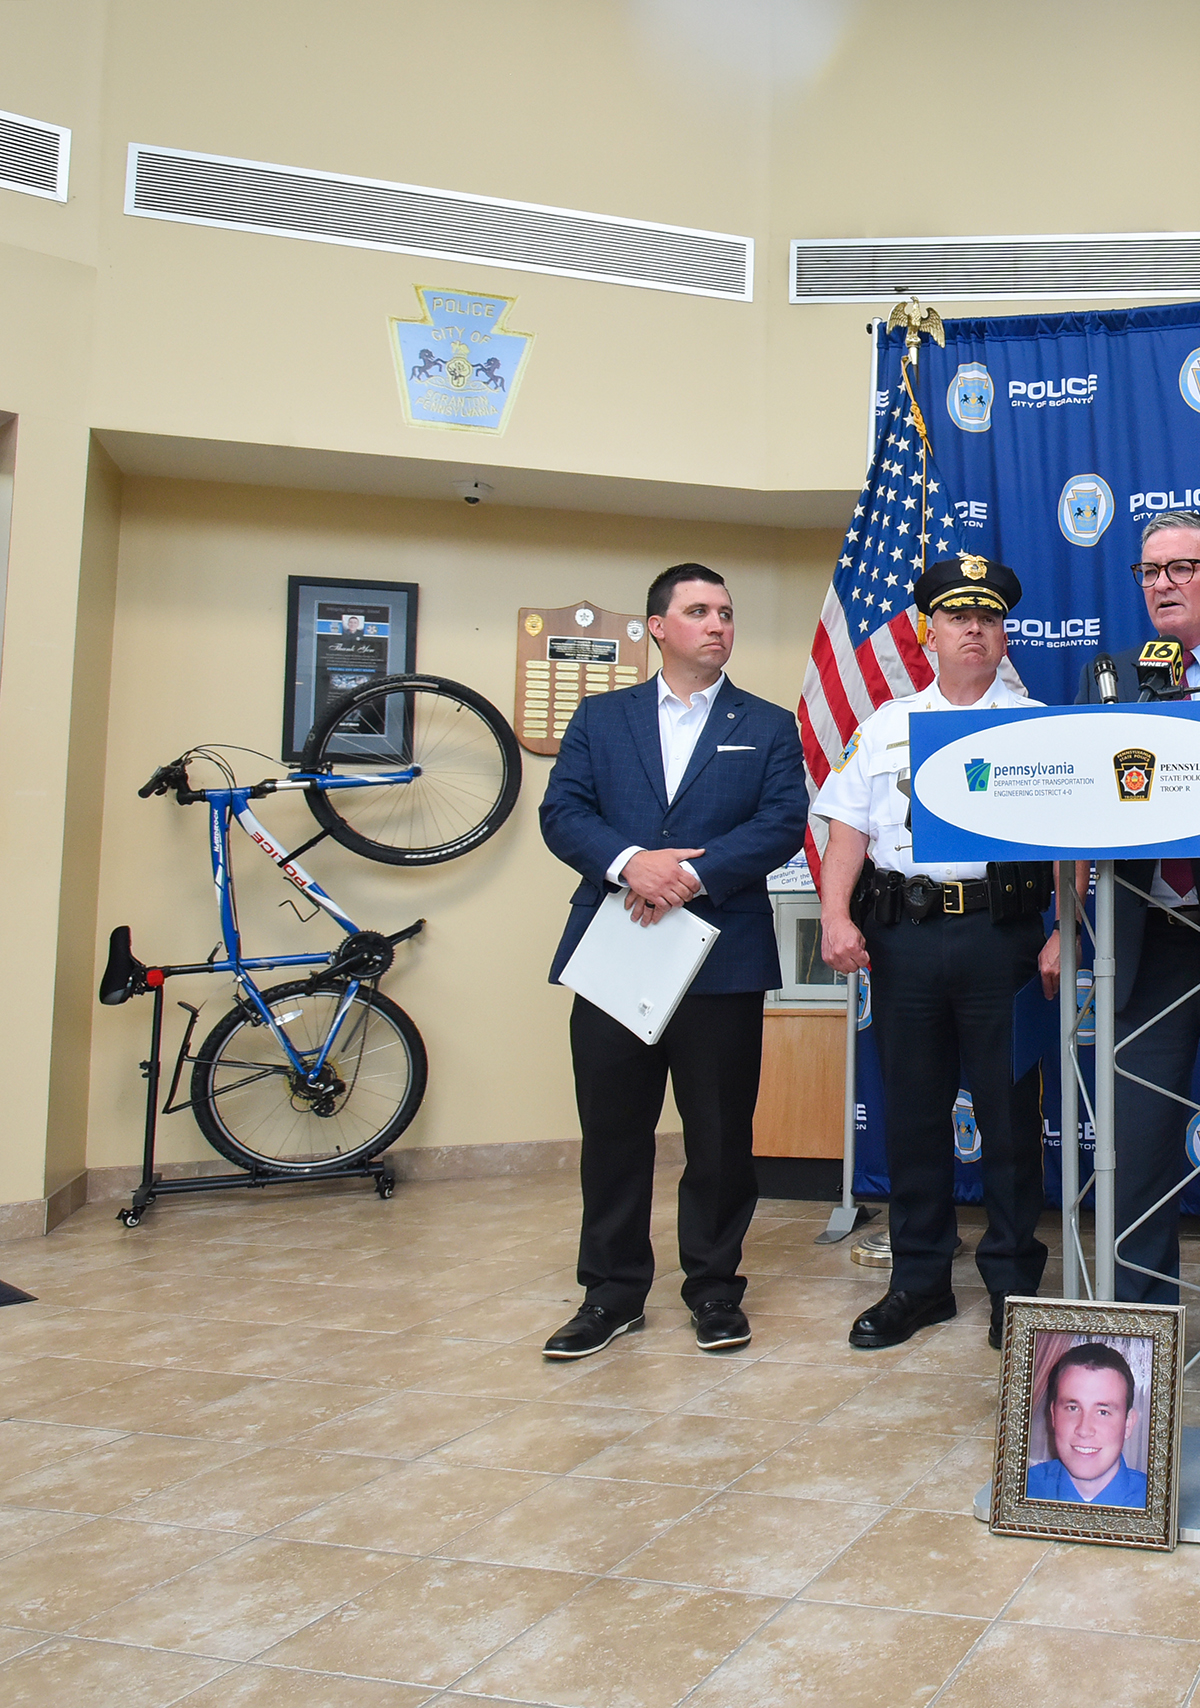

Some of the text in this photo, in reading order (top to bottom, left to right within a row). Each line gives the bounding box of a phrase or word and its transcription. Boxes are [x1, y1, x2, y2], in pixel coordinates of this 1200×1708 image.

[432, 296, 496, 318] POLICE
[431, 325, 493, 345] CITY OF
[1008, 373, 1098, 400] POLICE
[425, 389, 490, 407] SCRANTON
[1011, 400, 1035, 408] CITY
[1036, 400, 1047, 409] OF
[415, 397, 500, 418] PENNSYLVANIA
[1133, 512, 1153, 522] CITY
[1003, 618, 1101, 639] POLICE
[1046, 639, 1099, 648] SCRANTON
[1144, 643, 1173, 658] 16
[994, 761, 1074, 778] pennsylvania
[994, 777, 1095, 787] DEPARTMENT OF TRANSPORTATION
[994, 789, 1034, 797] ENGINEERING
[781, 876, 798, 885] Carry
